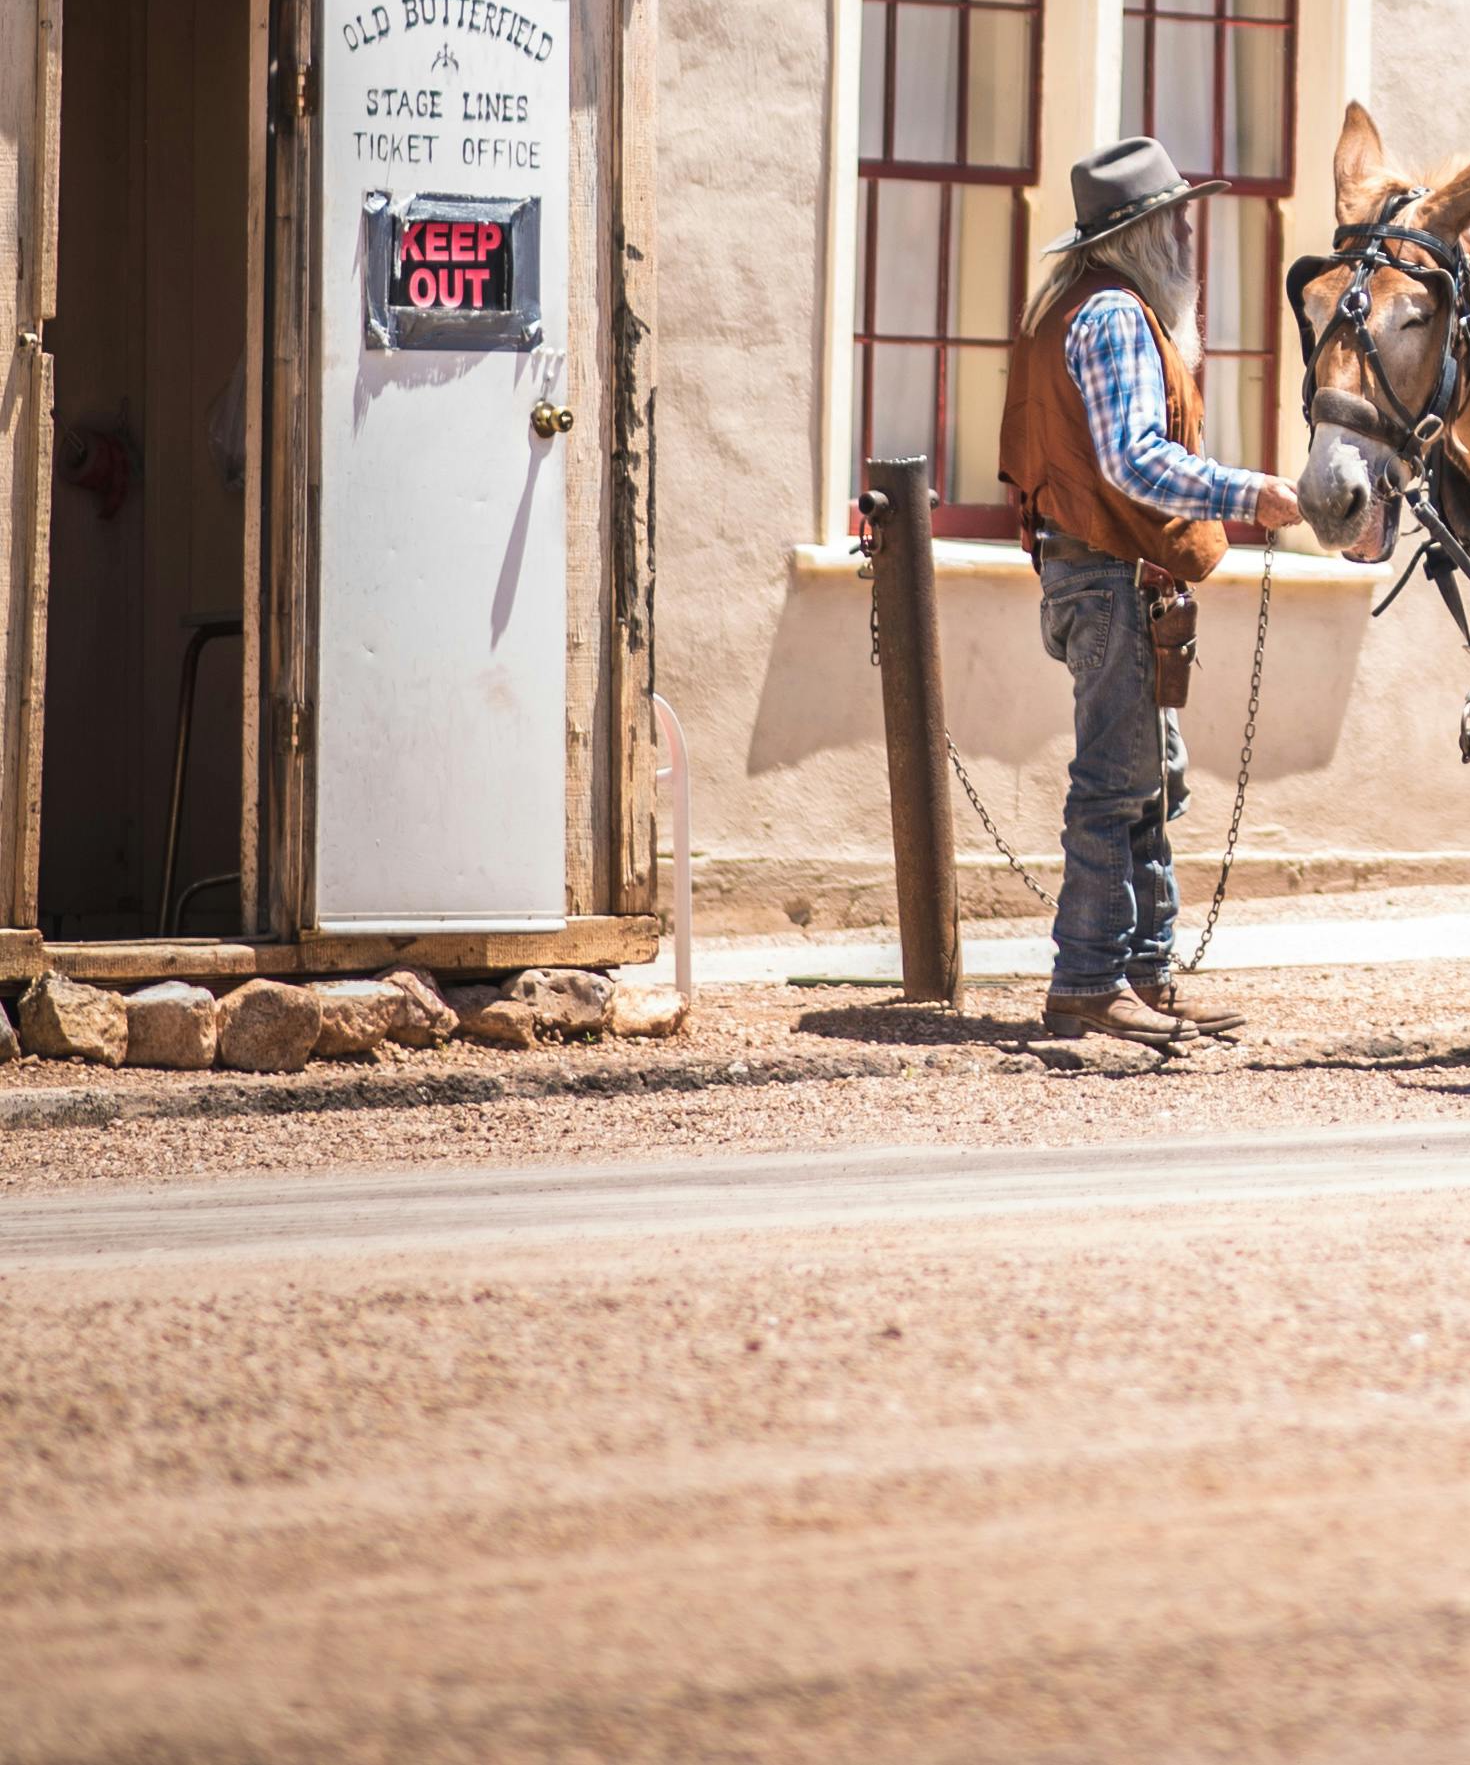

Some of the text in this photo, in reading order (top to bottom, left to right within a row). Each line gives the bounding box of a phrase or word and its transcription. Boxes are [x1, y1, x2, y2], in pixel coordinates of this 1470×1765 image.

[342, 5, 391, 53] OLD
[366, 88, 529, 122] STAGE LINES
[353, 131, 541, 170] TICKET OFFICE
[400, 221, 503, 262] KEEP
[409, 268, 491, 308] OUT
